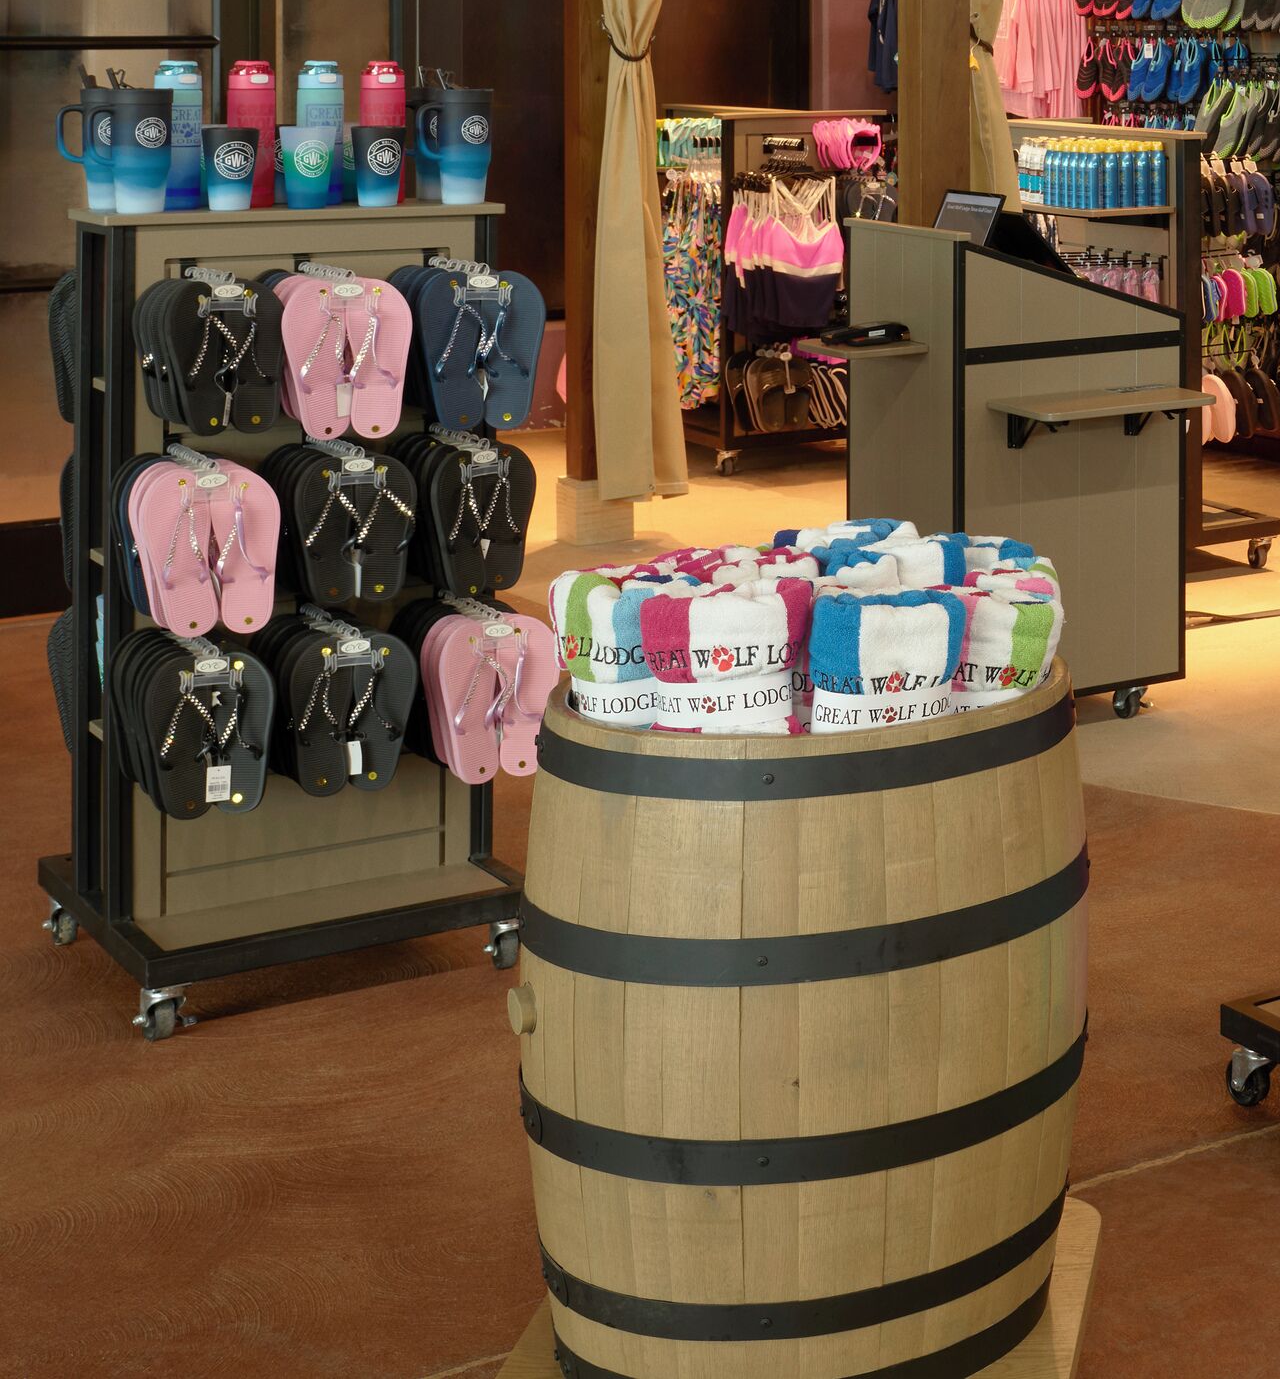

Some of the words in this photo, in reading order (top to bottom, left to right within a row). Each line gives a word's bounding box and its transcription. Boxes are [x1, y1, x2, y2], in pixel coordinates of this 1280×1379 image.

[144, 127, 160, 139] GWL
[225, 153, 247, 168] GWL
[303, 152, 322, 166] GWL
[376, 150, 395, 164] GWL
[593, 641, 645, 665] LODG
[648, 649, 688, 671] REAT
[815, 704, 861, 726] GREAT
